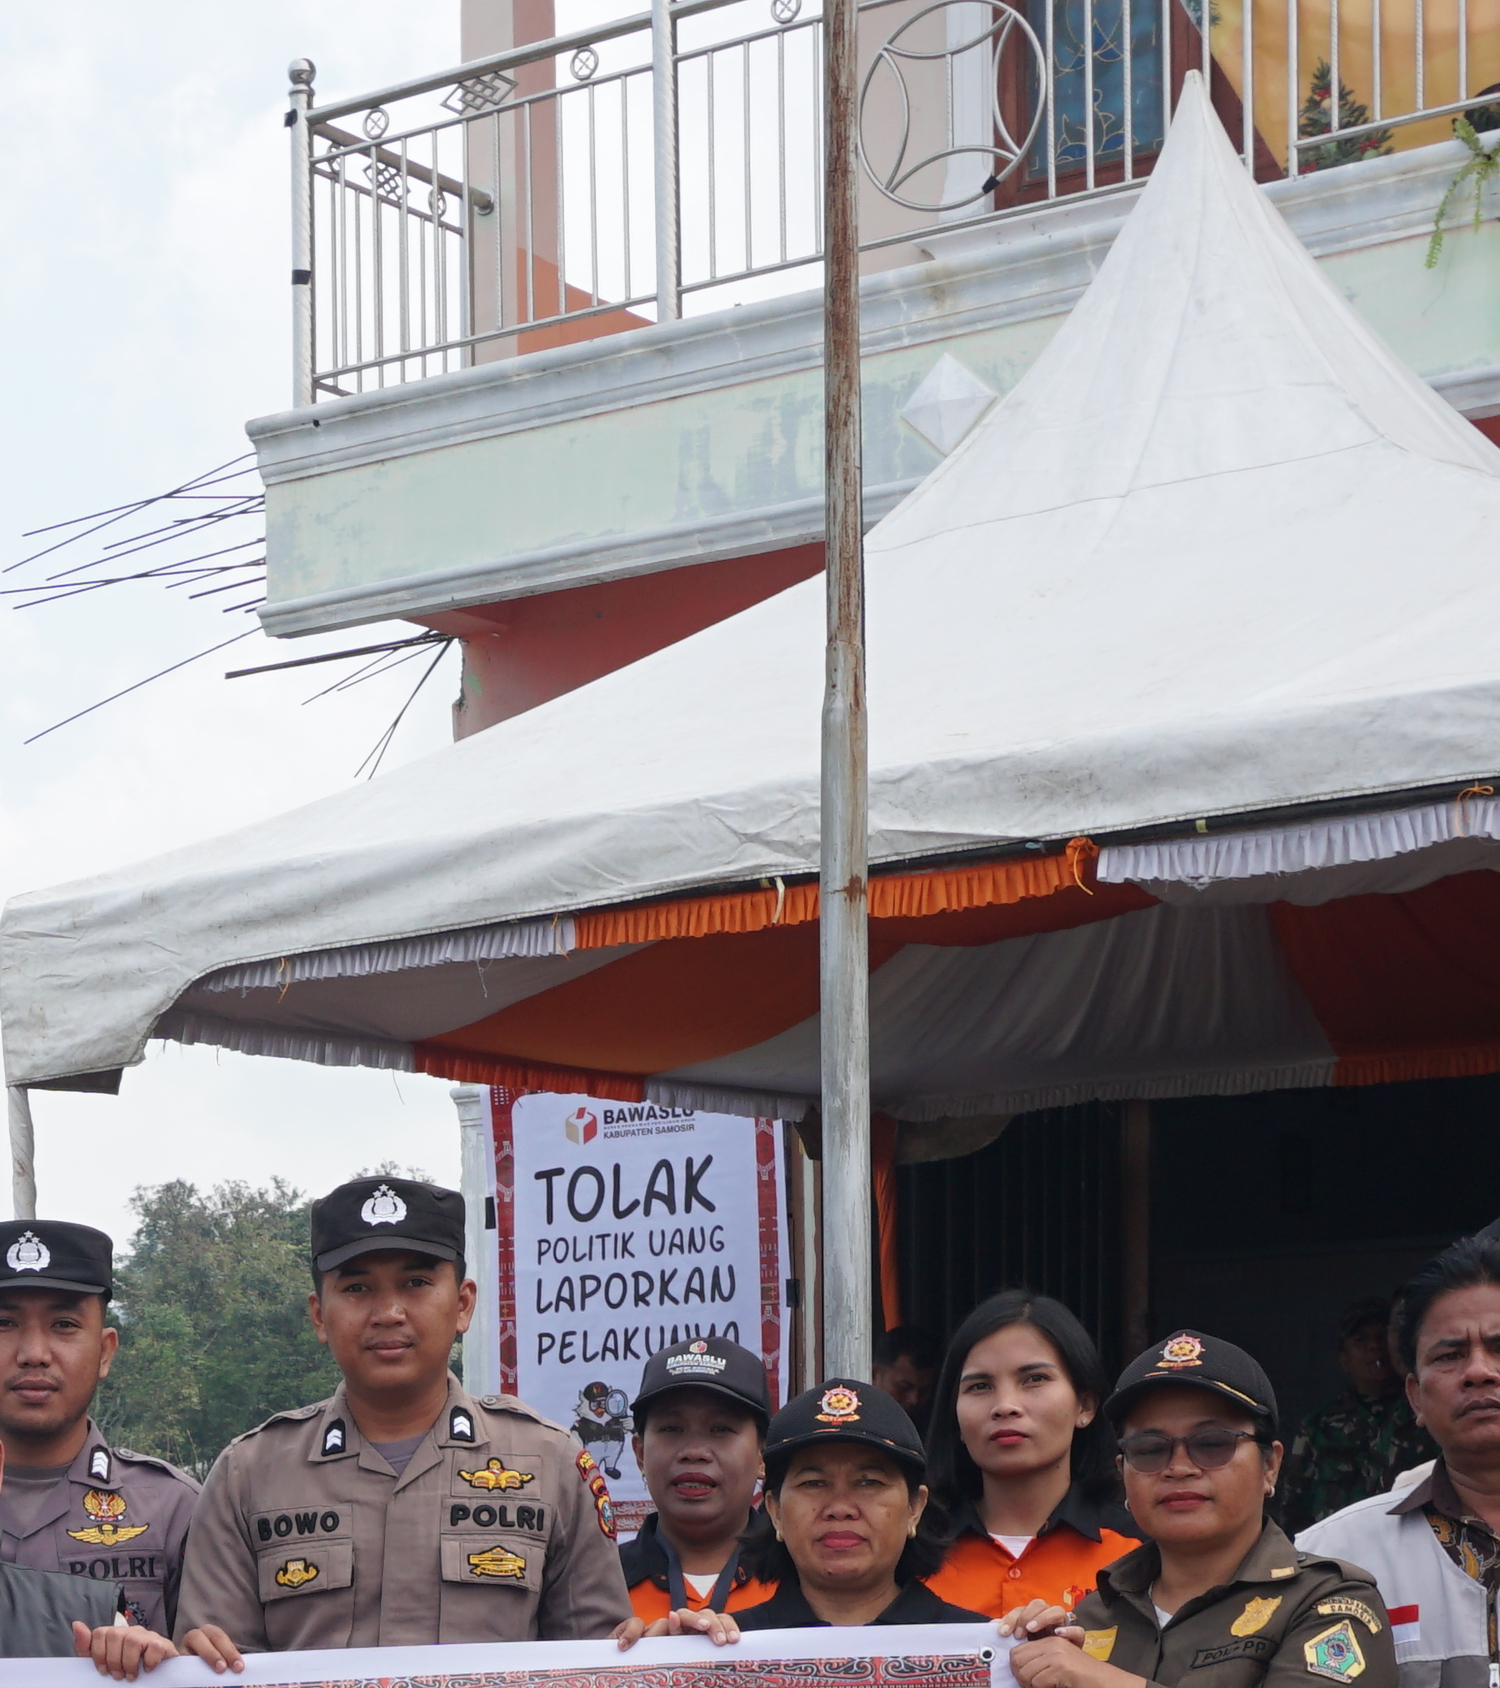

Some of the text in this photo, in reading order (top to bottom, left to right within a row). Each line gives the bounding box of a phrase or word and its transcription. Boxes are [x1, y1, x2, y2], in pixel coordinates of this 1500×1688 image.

[603, 1127, 653, 1139] KABUPATEN
[655, 1123, 695, 1135] SAMOSIR
[534, 1154, 716, 1225] TOLAK
[537, 1225, 725, 1266] POLITIK UANG
[536, 1264, 736, 1314] LAPORKAN
[257, 1510, 340, 1541] BOWO
[450, 1504, 545, 1532] POLRI
[69, 1557, 156, 1579] POLRI
